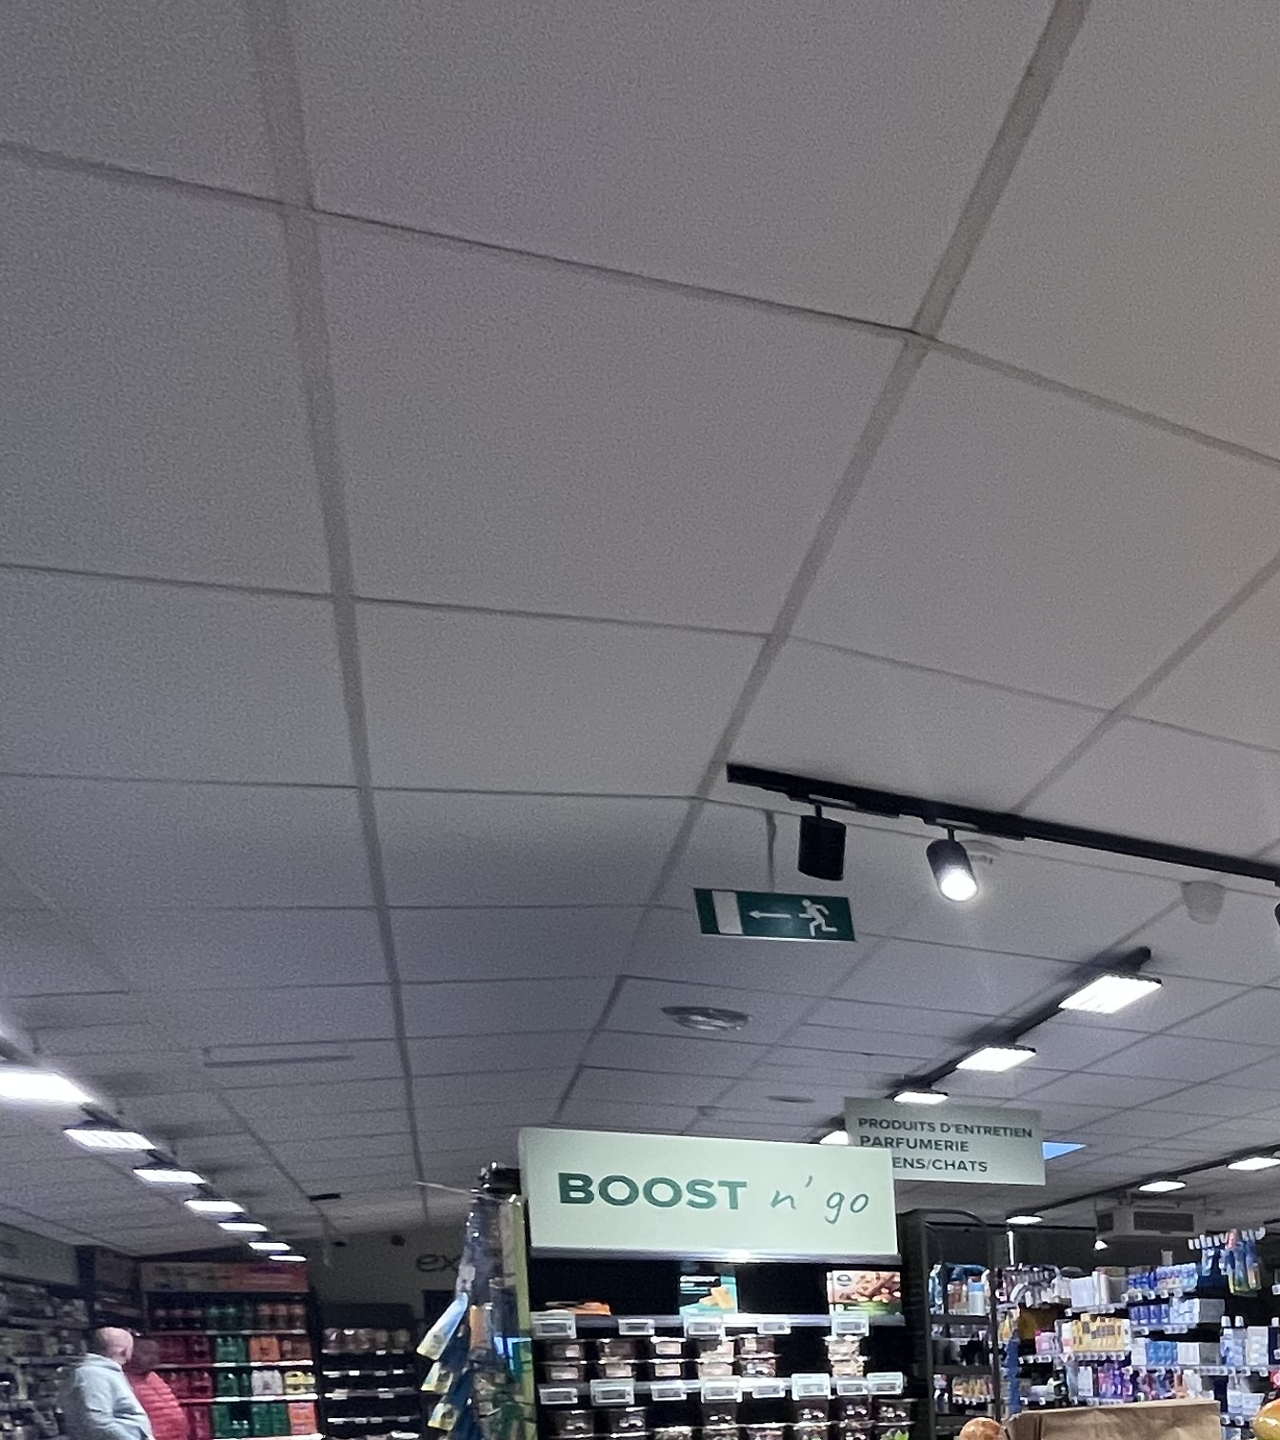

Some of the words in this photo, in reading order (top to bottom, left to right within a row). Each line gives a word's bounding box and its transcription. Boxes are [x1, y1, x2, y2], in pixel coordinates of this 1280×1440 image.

[858, 1117, 936, 1133] PRODUITS
[939, 1121, 1033, 1139] D'ENTRETIEN
[860, 1135, 969, 1153] PARFUMERIE
[892, 1156, 988, 1173] ENS/CHATS
[558, 1172, 748, 1210] BOOST
